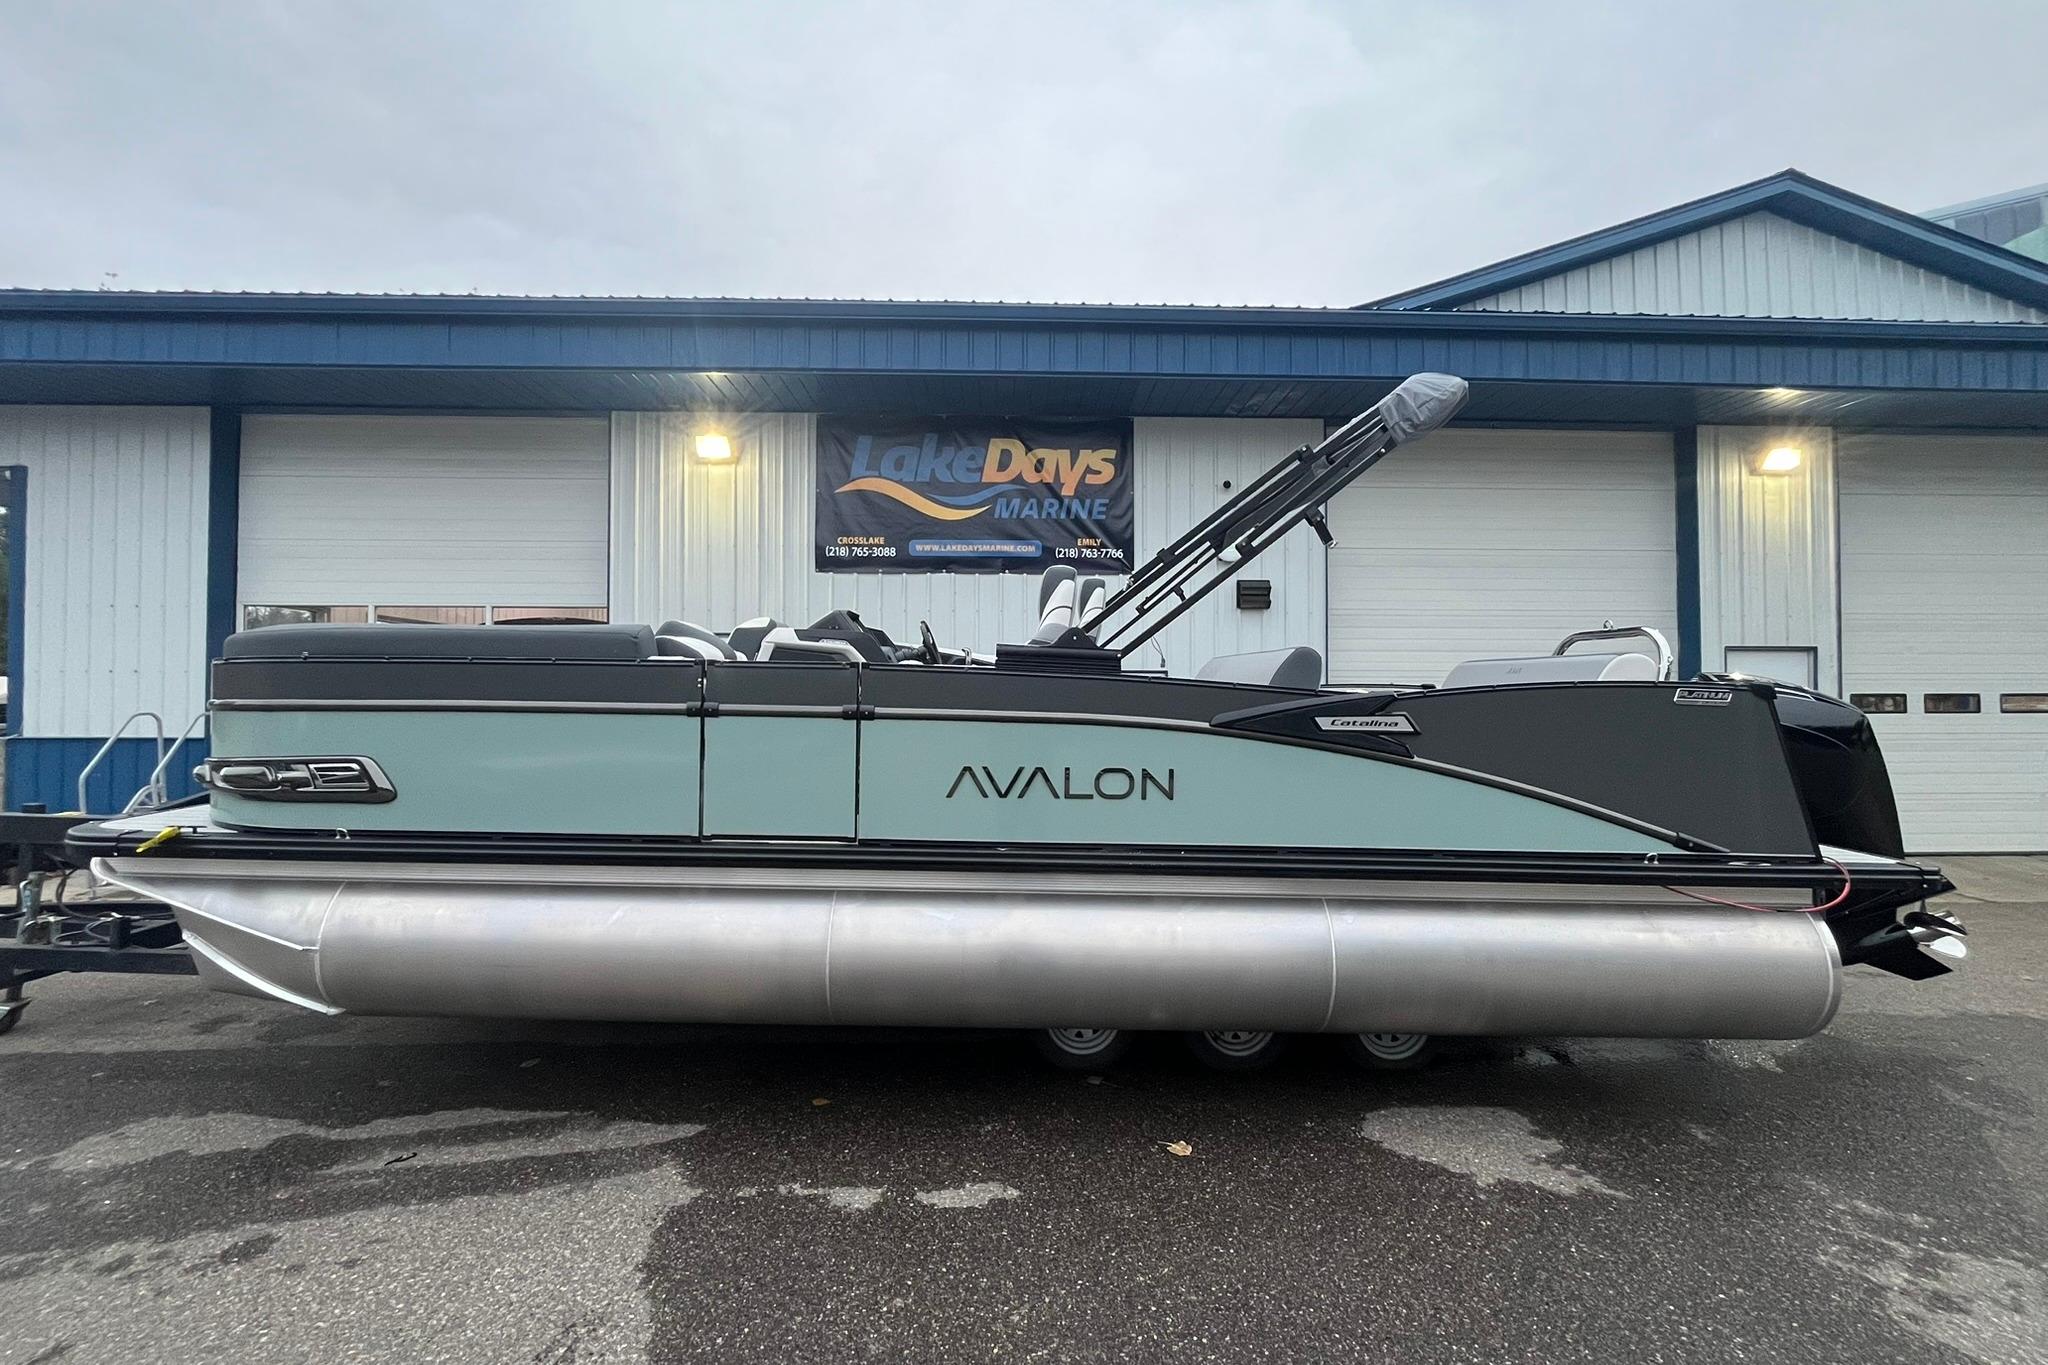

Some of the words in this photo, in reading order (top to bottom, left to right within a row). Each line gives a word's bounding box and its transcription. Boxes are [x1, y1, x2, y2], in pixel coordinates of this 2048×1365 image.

[993, 498, 1110, 520] MARINE
[837, 536, 885, 545] CROSSLAKE
[1077, 538, 1102, 546] EMILY
[825, 545, 849, 557] (218)
[851, 546, 897, 557] 765-3088
[915, 544, 1036, 553] WWW.LAKEDAYSMARINE.COM
[1055, 547, 1079, 559] (218)
[1080, 548, 1124, 559] 763-7766
[1330, 719, 1399, 728] Catalina
[945, 766, 1174, 800] AVALON
